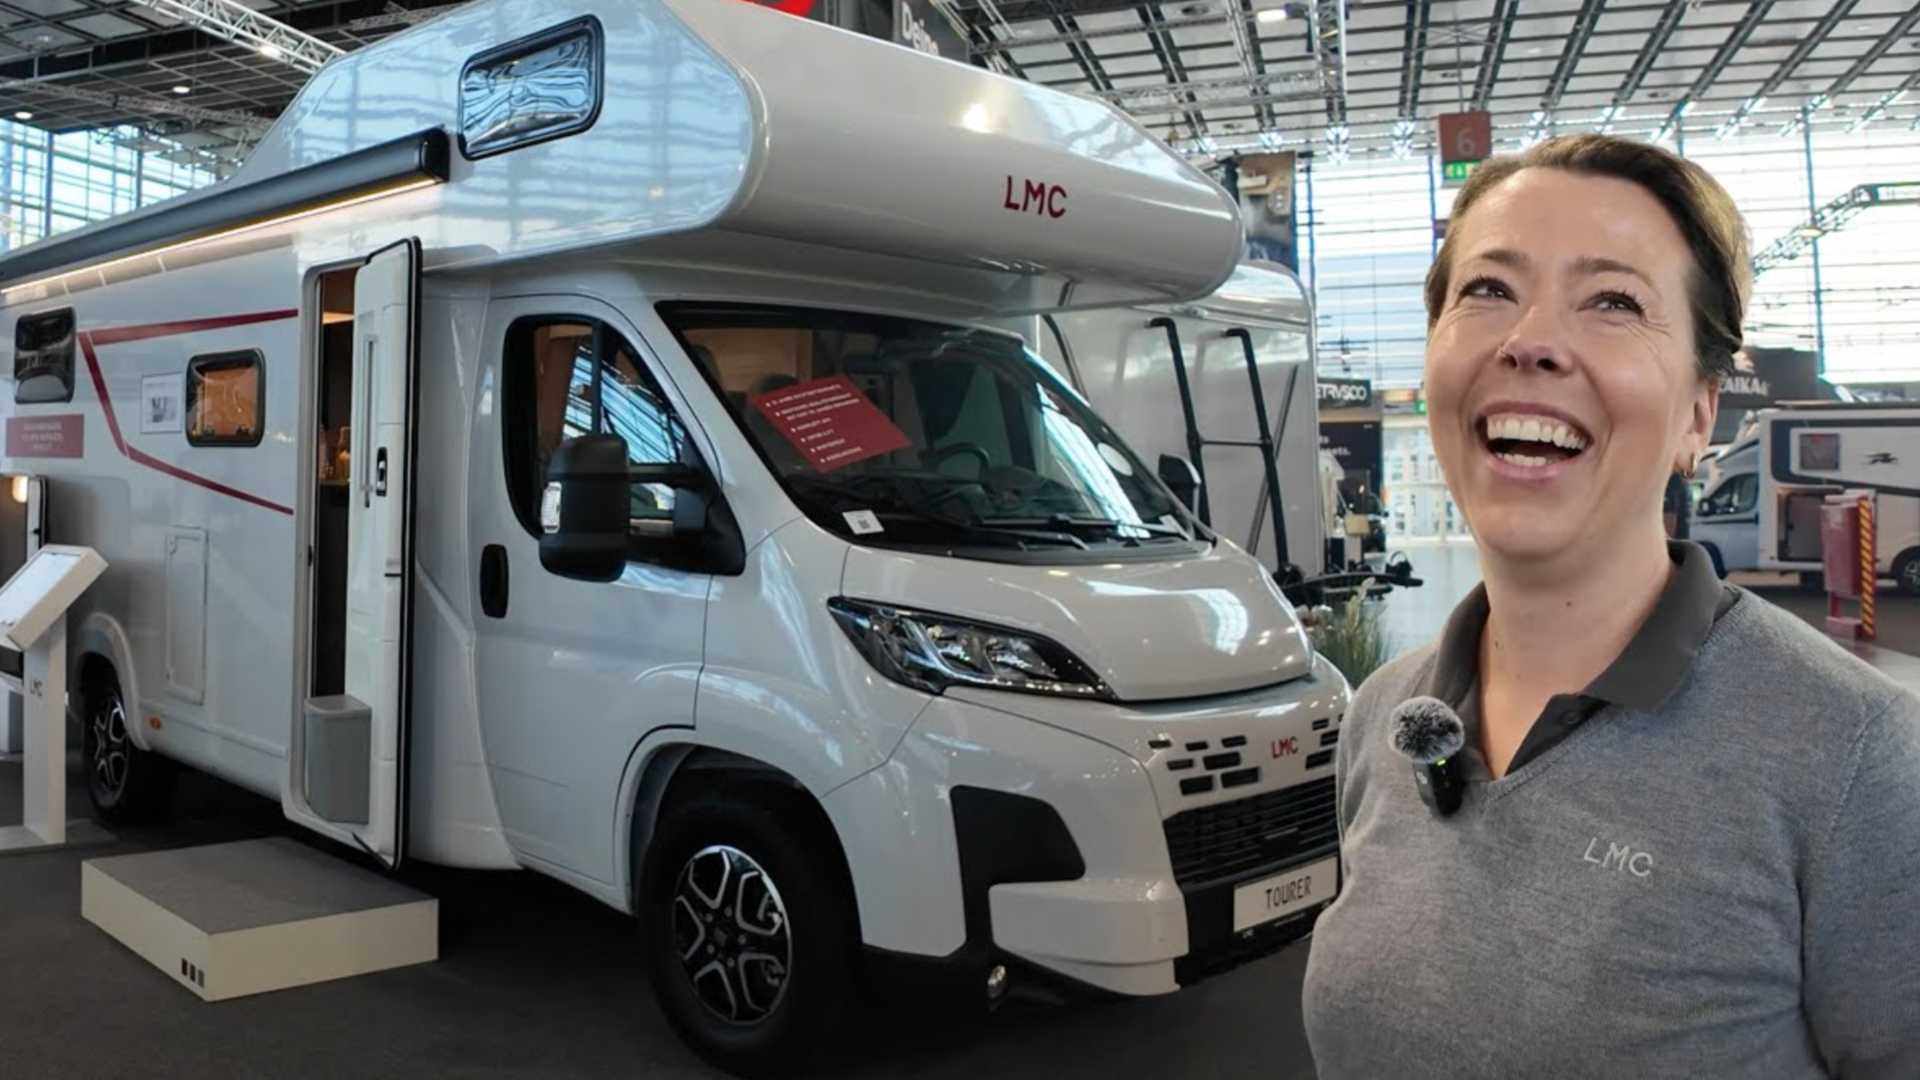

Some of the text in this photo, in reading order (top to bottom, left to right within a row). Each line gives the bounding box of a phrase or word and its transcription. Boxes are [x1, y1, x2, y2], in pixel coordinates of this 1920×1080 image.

[1457, 128, 1476, 156] 6
[1004, 175, 1067, 219] LMC
[1272, 736, 1299, 759] LMC
[1583, 837, 1654, 877] LMC
[1265, 876, 1311, 909] TOURER
